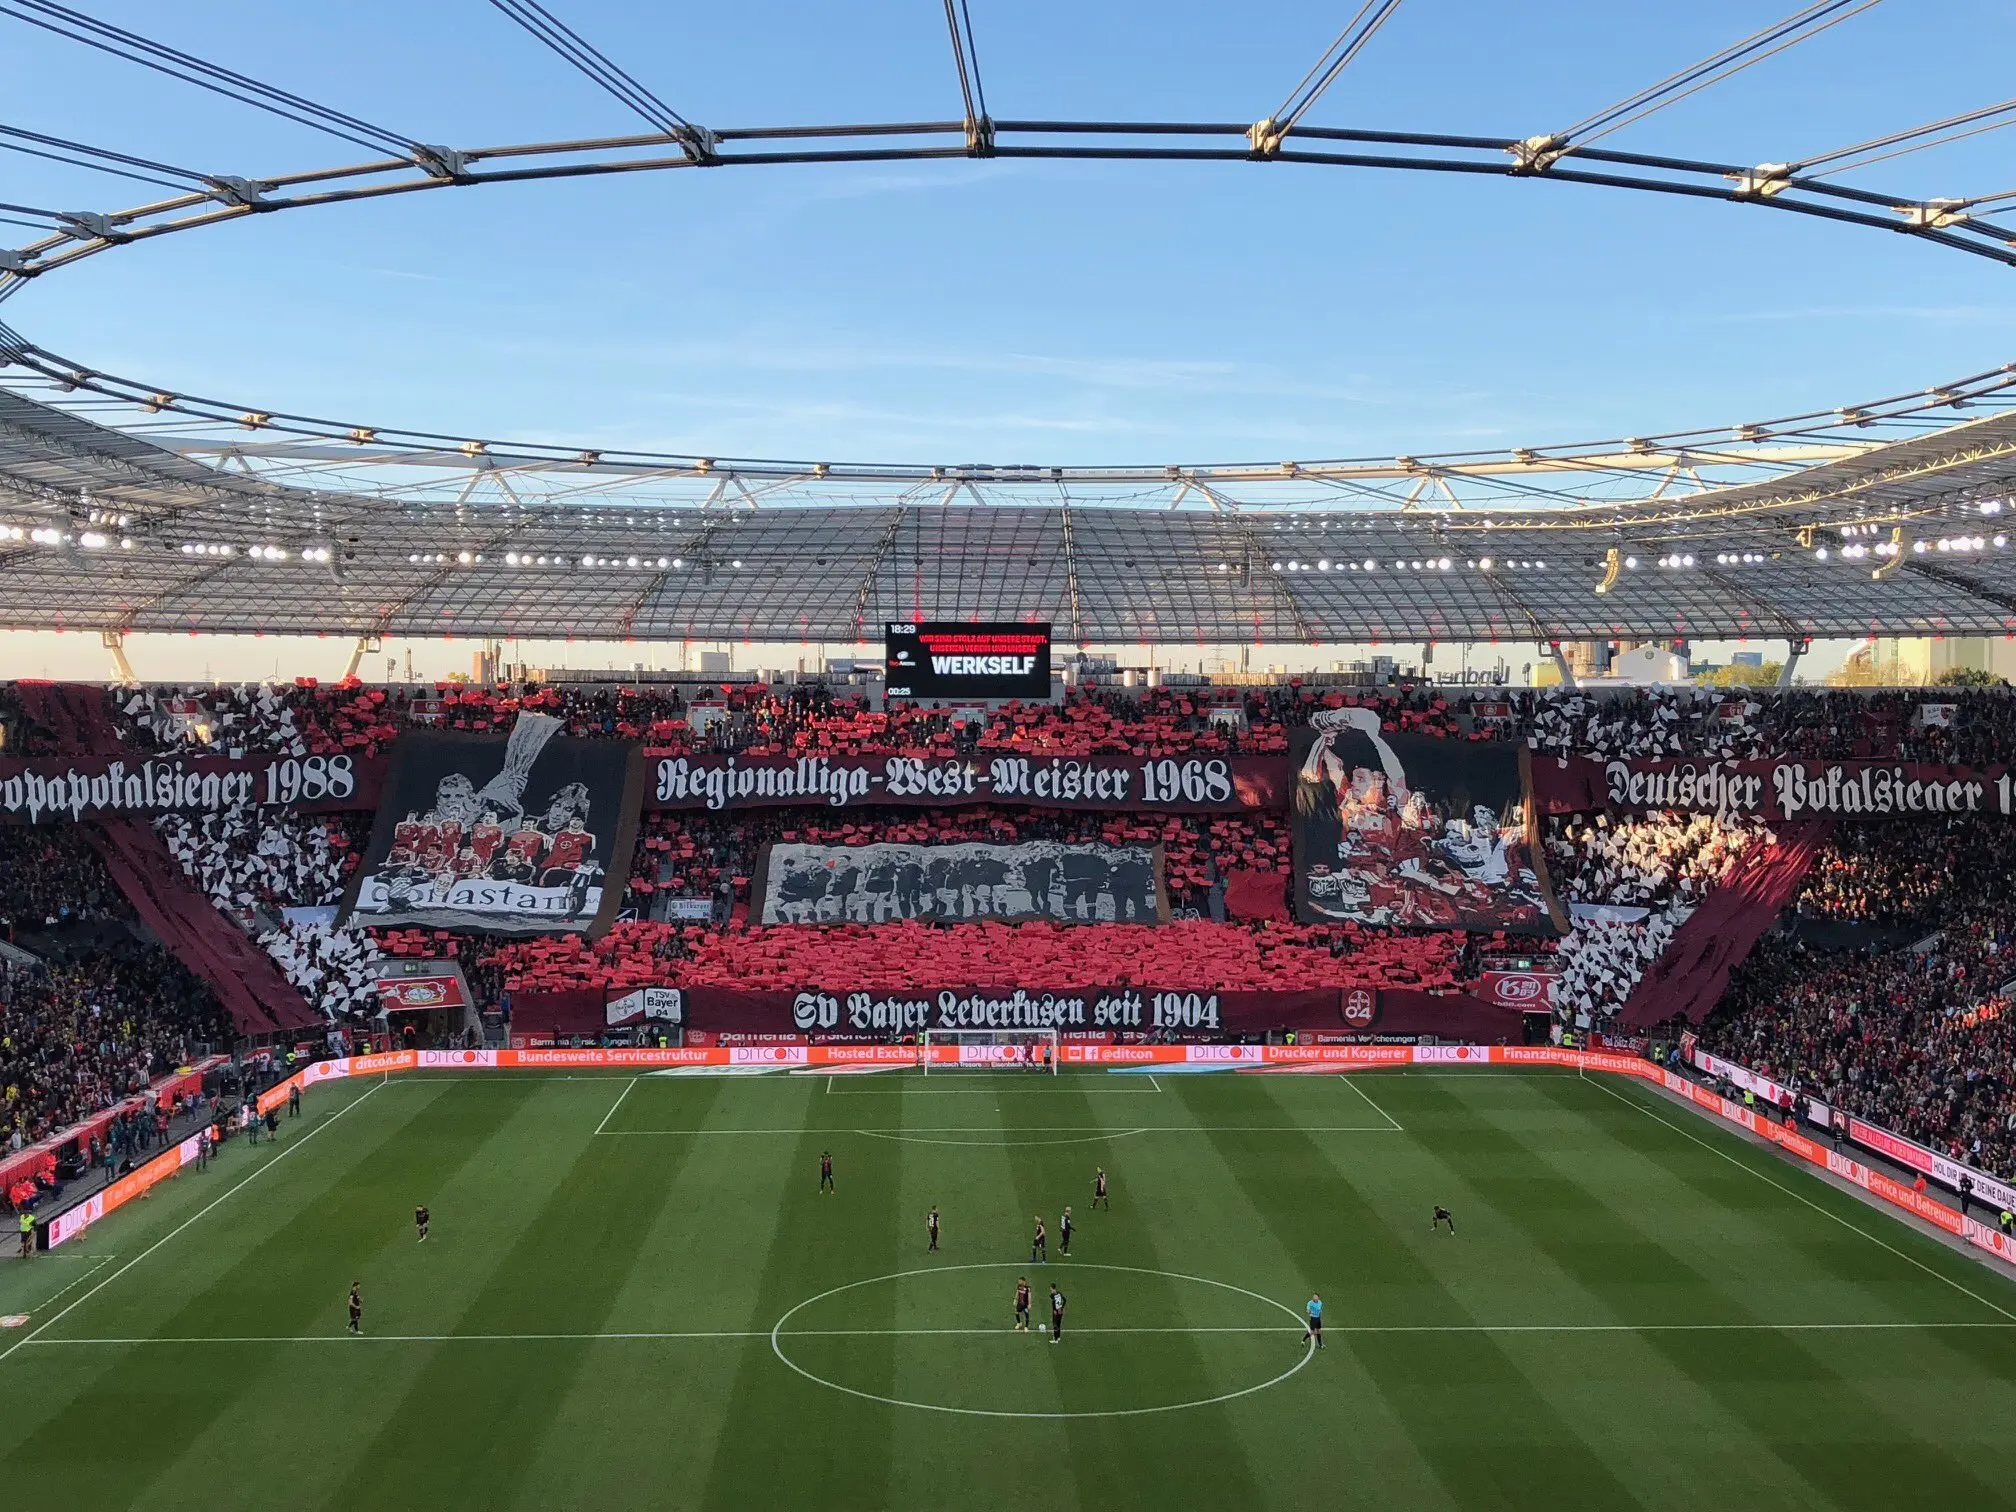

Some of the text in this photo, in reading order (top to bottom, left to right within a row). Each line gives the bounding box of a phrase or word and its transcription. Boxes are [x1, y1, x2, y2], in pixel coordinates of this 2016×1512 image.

[890, 624, 916, 634] 18:29
[953, 635, 976, 643] STOLZ
[976, 635, 991, 643] AUF
[992, 635, 1020, 643] UNSERE
[931, 656, 1036, 674] WERKSELF
[888, 687, 911, 696] 00:25
[0, 754, 354, 824] opapokalsieger 1988
[656, 756, 1232, 810] Regionalliga-West-Meister 1968
[1605, 760, 2016, 821] Deutscher Pokalsieger 1
[647, 997, 678, 1009] Bayer
[847, 991, 930, 1034] Bayer
[938, 990, 1086, 1029] Leverkusen
[1094, 990, 1143, 1027] seit
[1150, 992, 1220, 1029] 1904
[1345, 1006, 1372, 1020] 04
[530, 1038, 570, 1046] Barmnia
[1317, 1034, 1356, 1043] Barmenia
[426, 1050, 489, 1064] DITCON
[517, 1048, 708, 1062] Bundesweite Servicestruktur
[738, 1047, 799, 1060] DITCON
[828, 1048, 939, 1062] Hosted Exchange
[1101, 1048, 1153, 1060] @ditcon
[1194, 1046, 1255, 1059] DITCON
[1269, 1047, 1407, 1061] Drucker und Kopierer
[1420, 1046, 1481, 1059] DITCON
[355, 1051, 412, 1070] ditcon.de
[1830, 1152, 1865, 1182] DITCON
[1933, 1160, 1946, 1176] HOL
[1946, 1165, 1958, 1180] DIR
[1976, 1180, 1995, 1199] DEINE
[1869, 1172, 1962, 1232] Service und Betreuung
[65, 1195, 99, 1232] DITCON
[1967, 1218, 2012, 1256] DITCON
